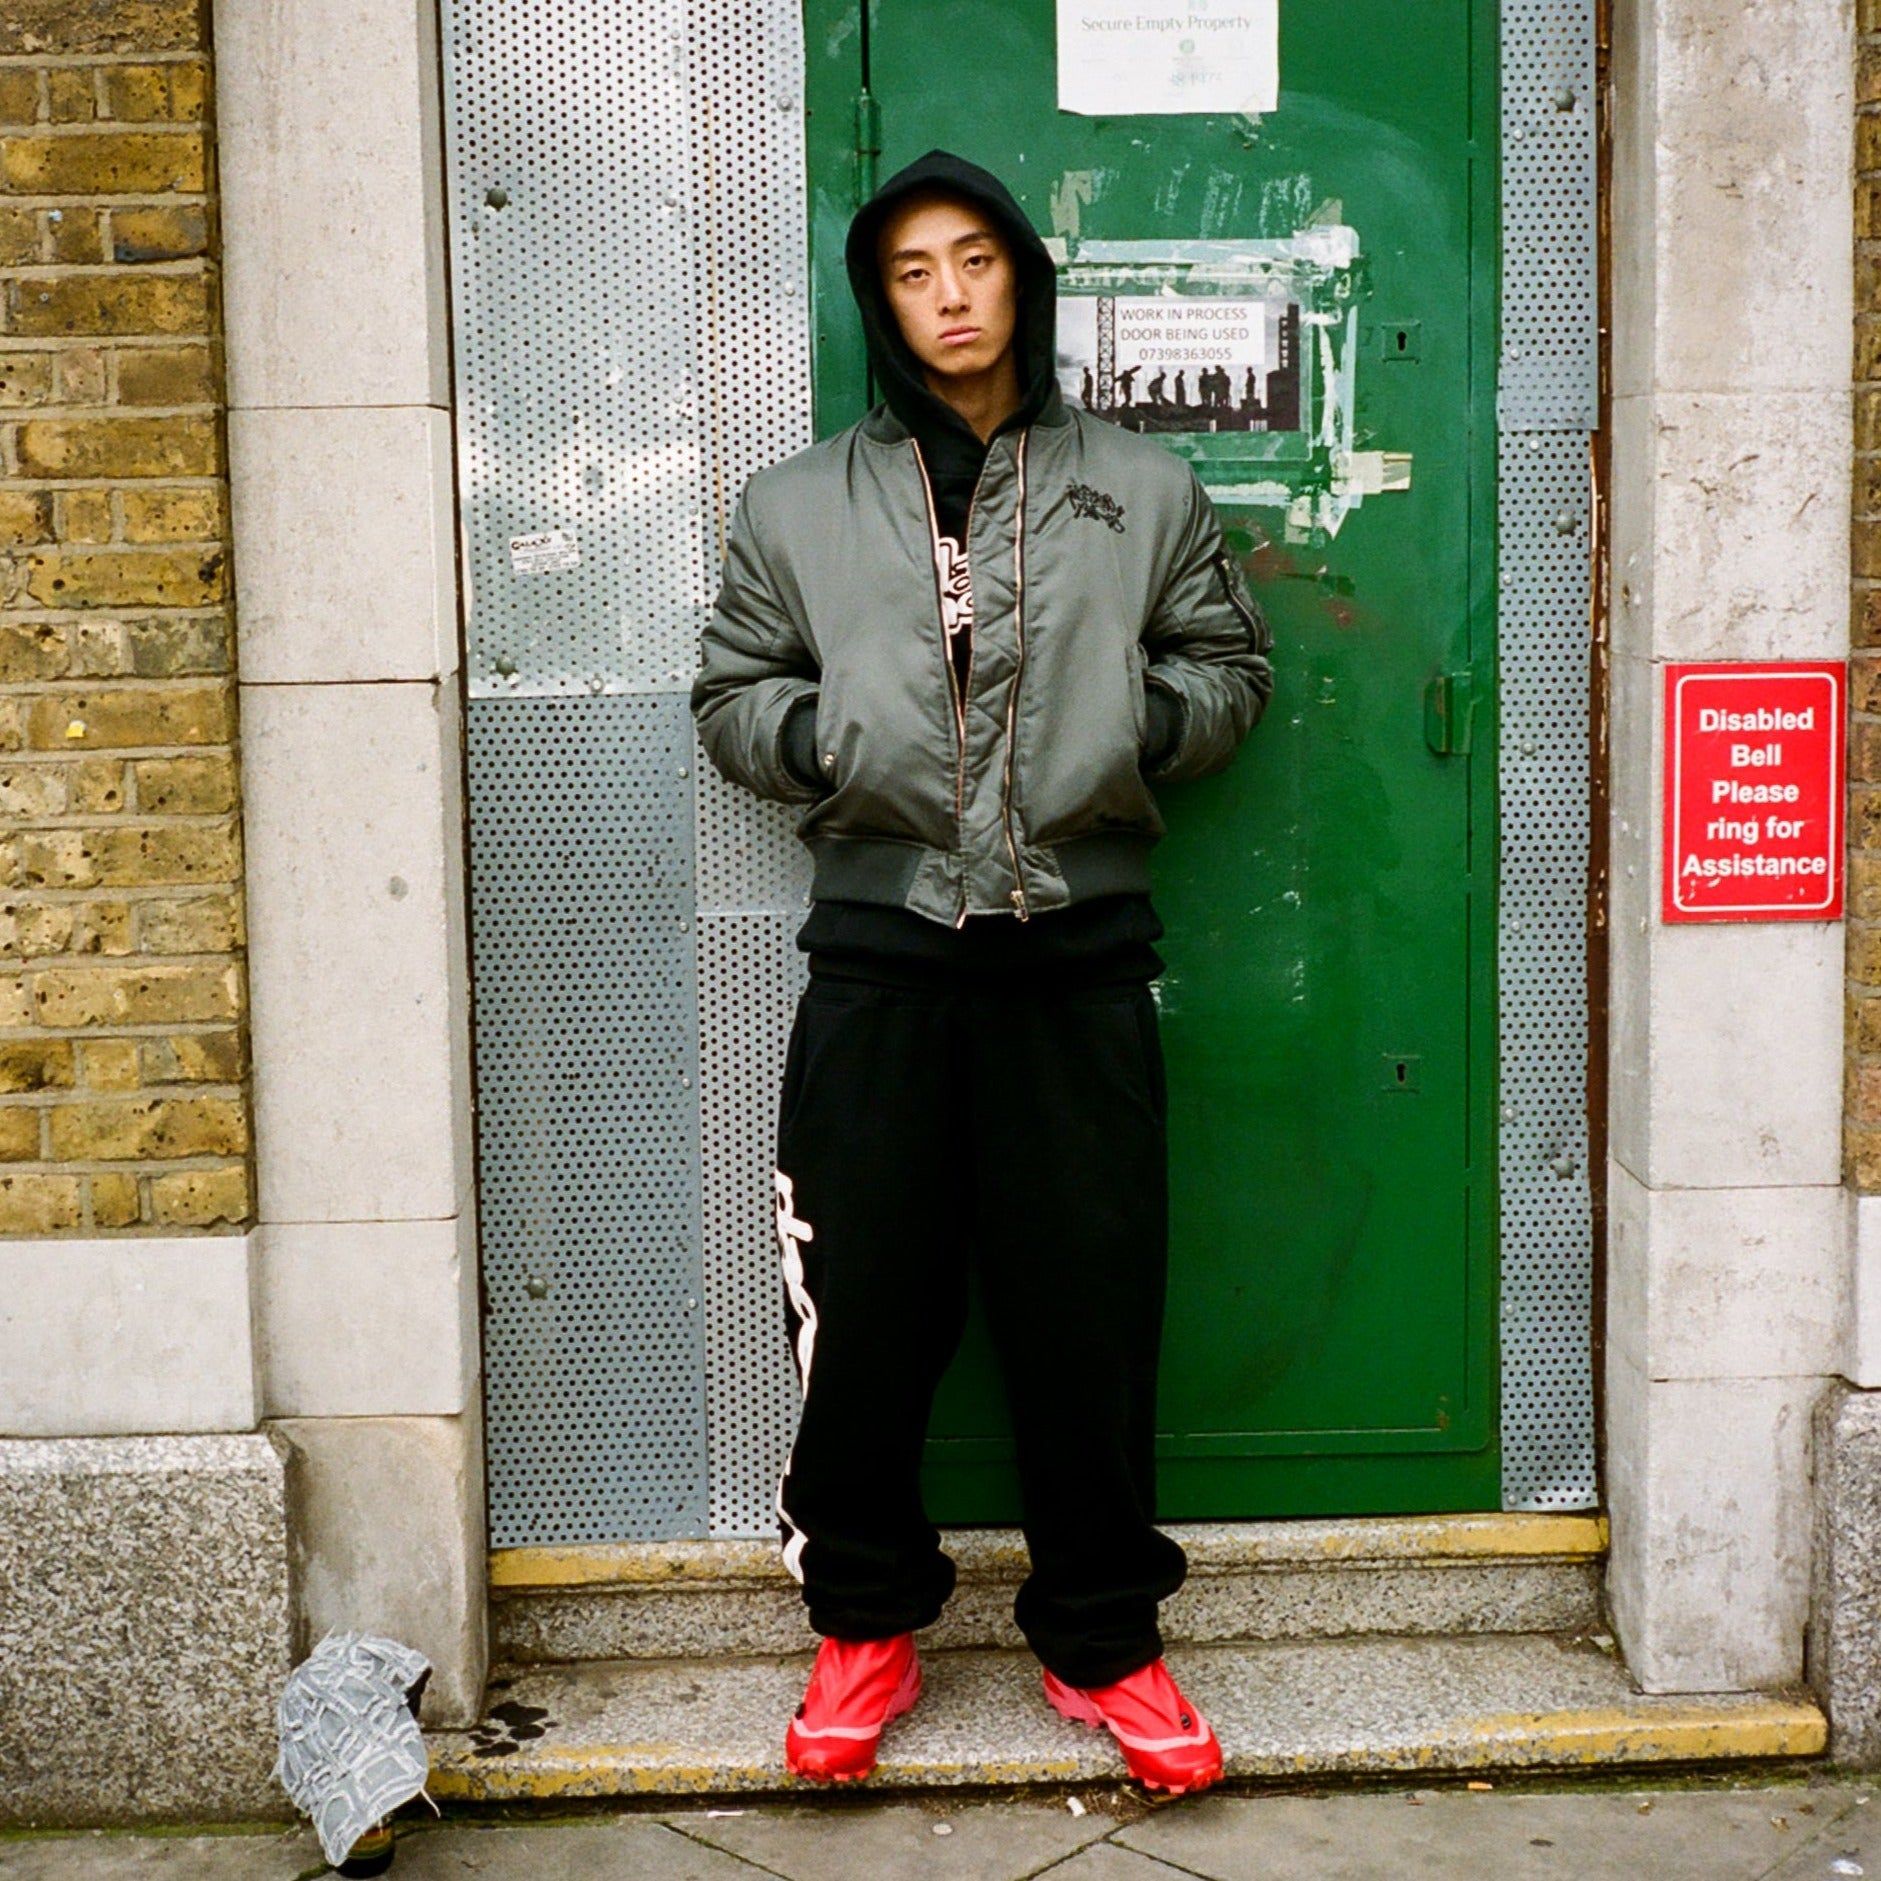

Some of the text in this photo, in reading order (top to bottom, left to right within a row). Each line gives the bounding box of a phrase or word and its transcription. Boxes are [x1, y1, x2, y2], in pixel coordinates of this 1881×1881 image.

[1081, 15, 1252, 34] Secure Empty Property
[1120, 307, 1248, 321] WORK IN PROCESS
[1120, 327, 1250, 341] DOOR BEING USED
[1138, 347, 1233, 361] 07398363055
[1699, 707, 1815, 732] Disabled
[1730, 743, 1782, 767] Bell
[1711, 780, 1800, 804] Please
[1706, 815, 1806, 845] ring for
[1681, 853, 1828, 877] Assistance
